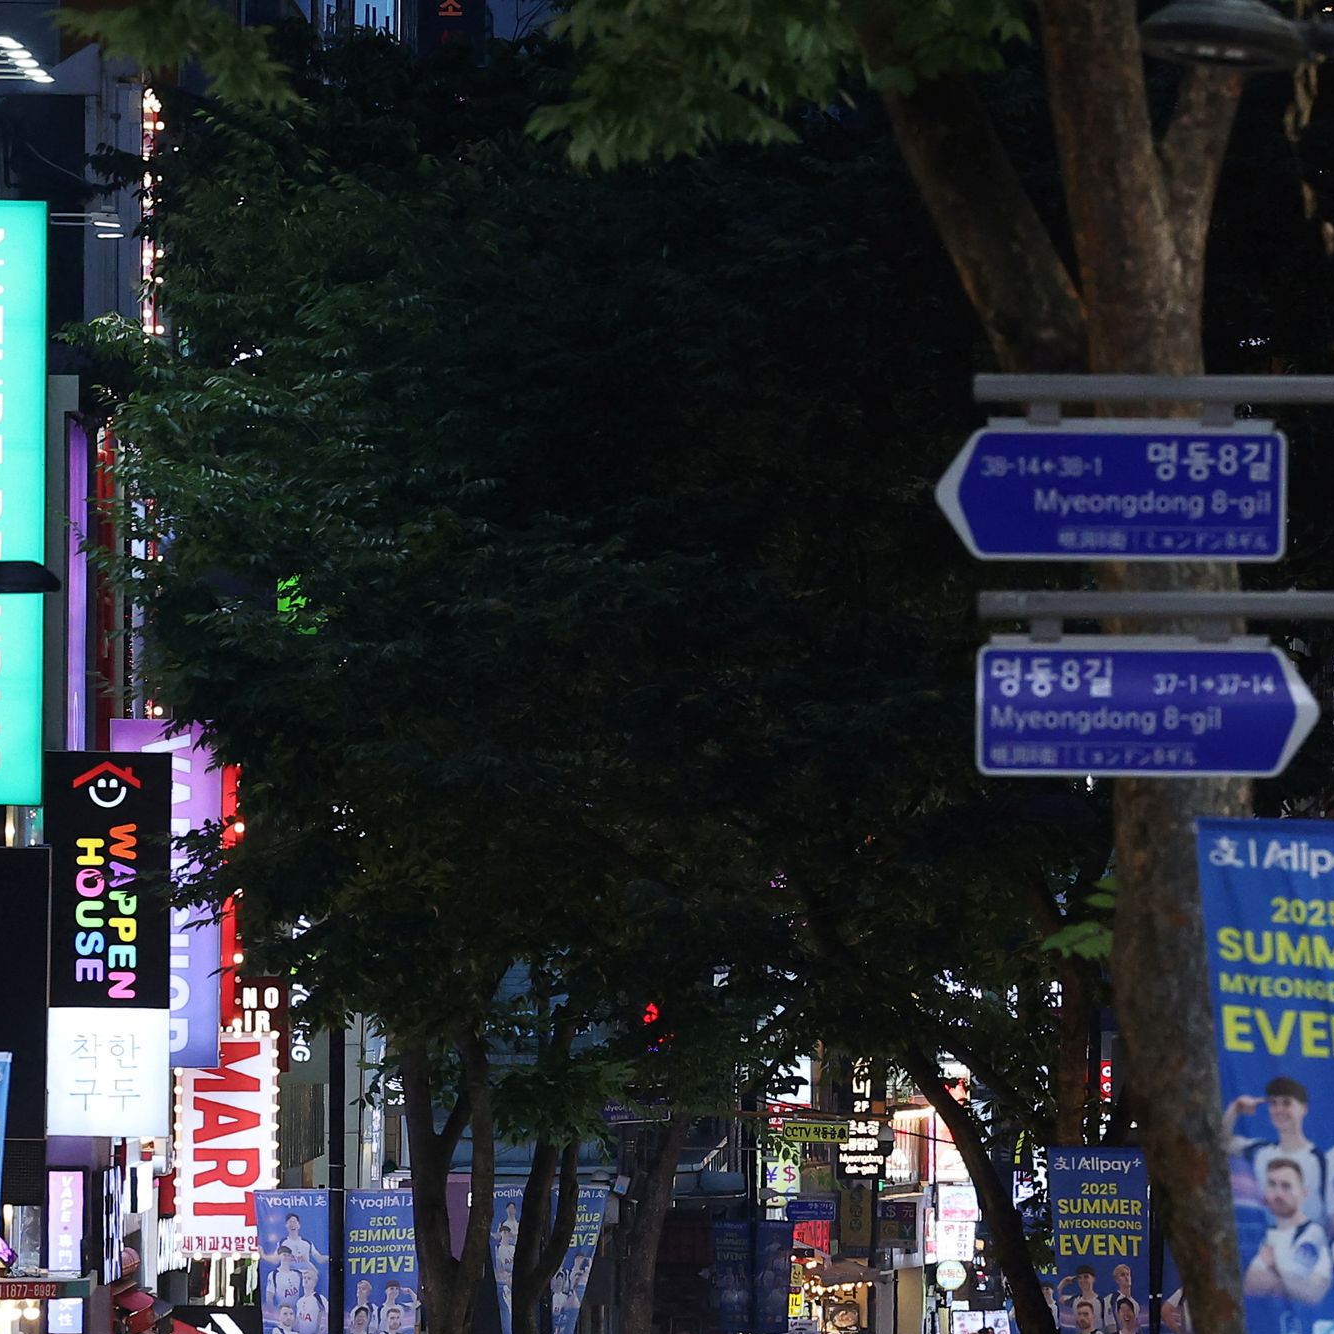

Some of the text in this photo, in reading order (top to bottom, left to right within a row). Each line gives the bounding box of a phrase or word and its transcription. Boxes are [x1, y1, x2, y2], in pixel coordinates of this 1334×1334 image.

[1146, 441, 1272, 482] 명동8길
[1034, 487, 1272, 519] Myeongdong 8-gil
[990, 657, 1113, 698] 명동8길
[990, 705, 1223, 735] Myeongdong 8-gil
[75, 836, 106, 983] HOUSE
[107, 823, 138, 999] WAPPEN
[69, 1031, 141, 1070] 착한
[68, 1078, 142, 1113] 구두
[192, 1041, 261, 1228] MART
[784, 1127, 811, 1138] CCTV
[812, 1126, 838, 1140] 작동중
[1080, 1182, 1118, 1196] 2025
[1057, 1198, 1143, 1217] SUMMER
[1058, 1219, 1143, 1231] MYEONGDONG
[1059, 1234, 1143, 1257] EVENT
